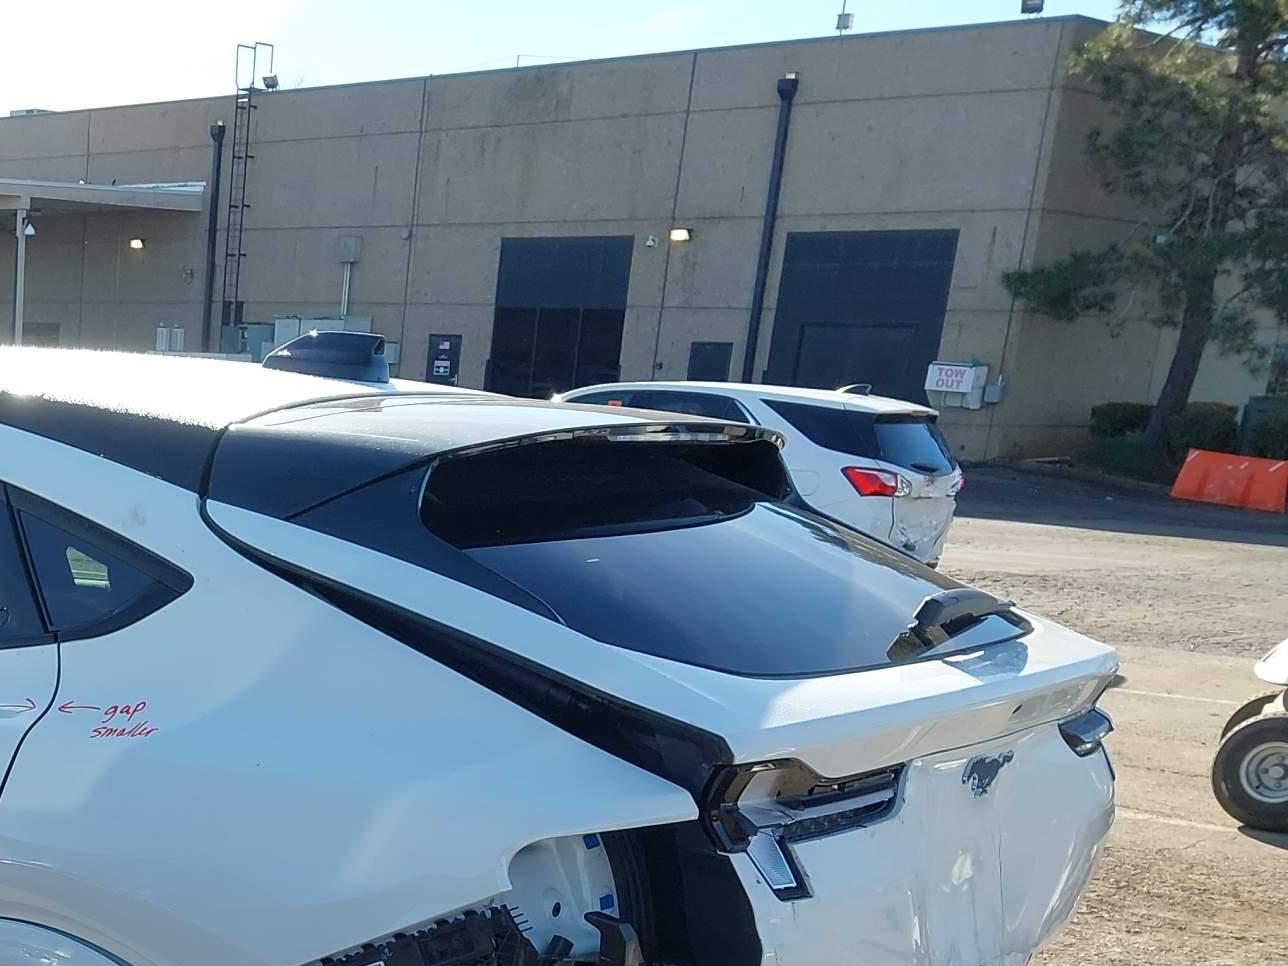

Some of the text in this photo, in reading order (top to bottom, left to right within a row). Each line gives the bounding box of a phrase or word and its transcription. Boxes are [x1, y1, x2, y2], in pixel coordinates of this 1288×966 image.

[937, 367, 966, 379] TOW
[935, 379, 963, 390] OUT
[101, 701, 147, 724] gap
